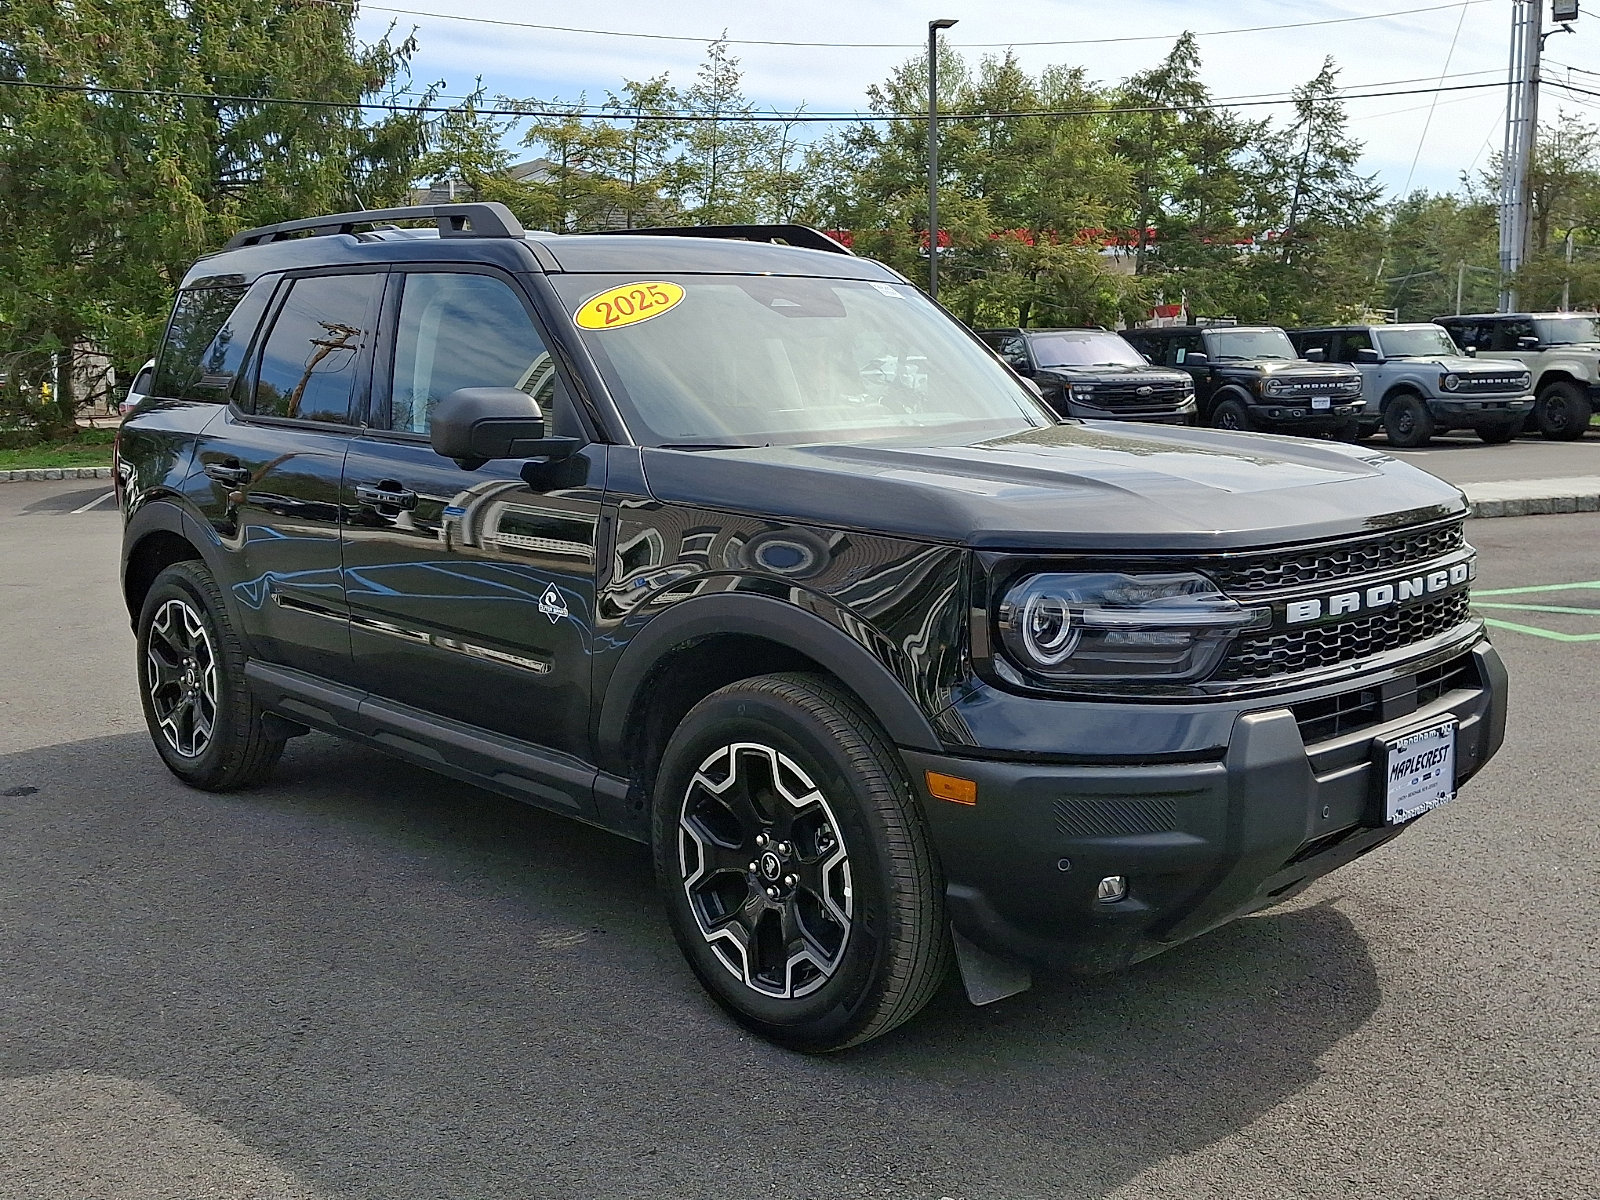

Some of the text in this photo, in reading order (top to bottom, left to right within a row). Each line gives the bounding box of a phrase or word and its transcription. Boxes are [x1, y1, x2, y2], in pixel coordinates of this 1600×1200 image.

[595, 285, 670, 325] 2025
[1286, 562, 1468, 624] BRONCO
[1441, 723, 1452, 734] NJ
[1389, 744, 1450, 782] MAPLECREST
